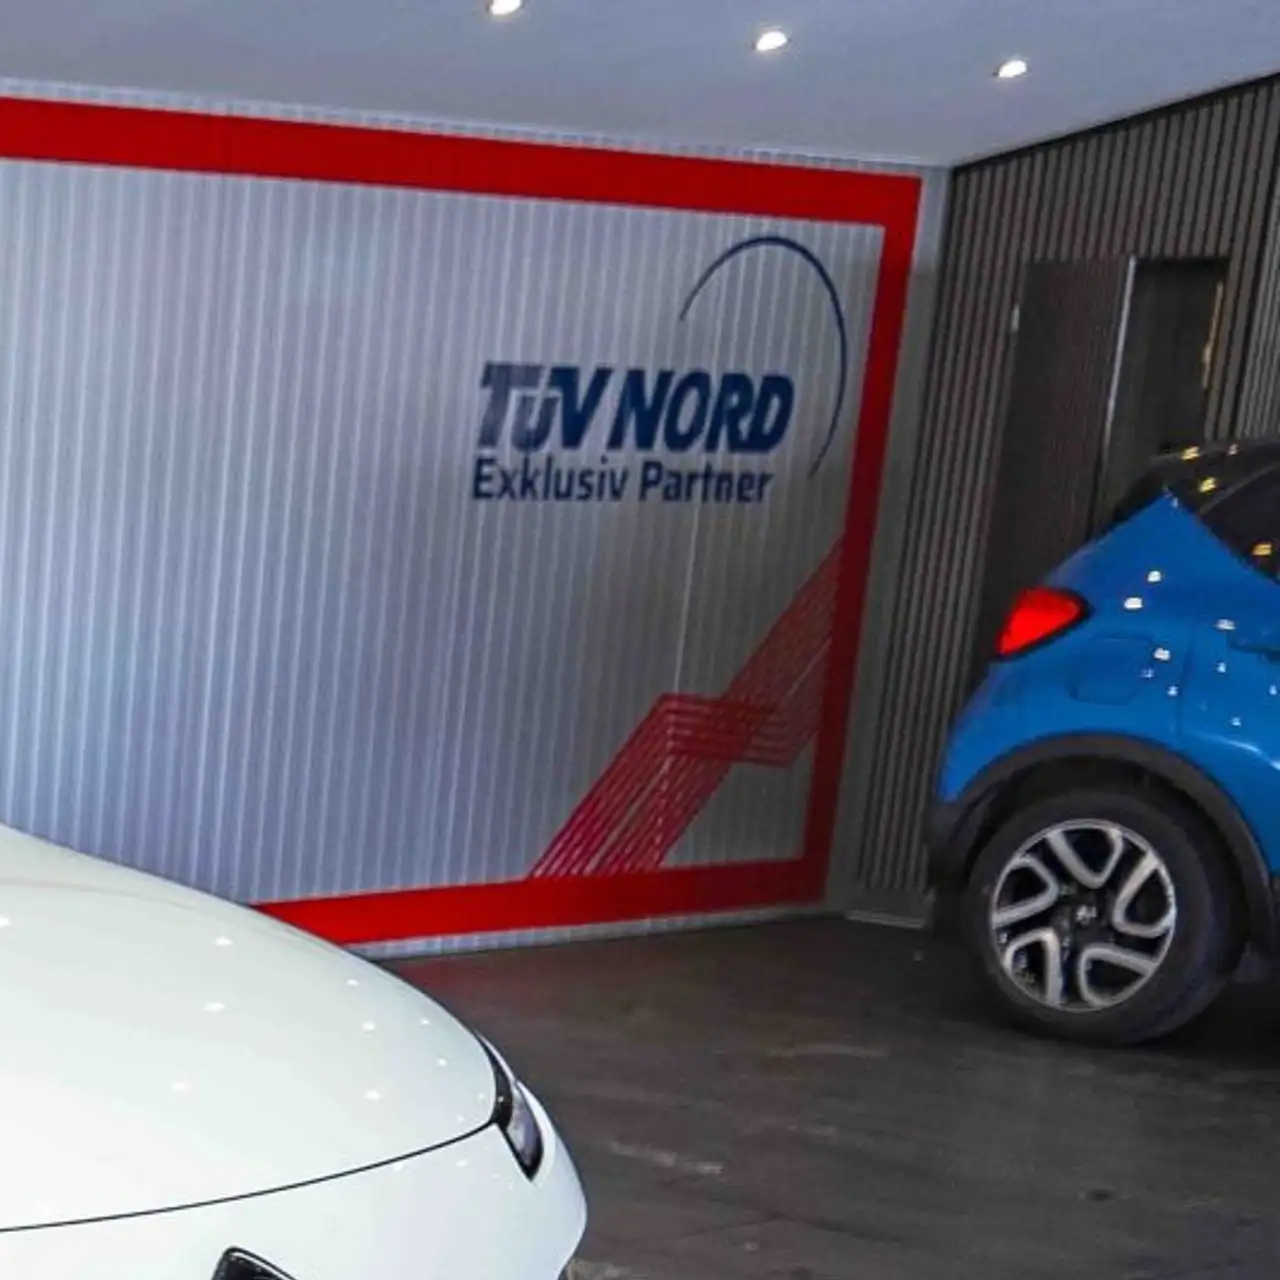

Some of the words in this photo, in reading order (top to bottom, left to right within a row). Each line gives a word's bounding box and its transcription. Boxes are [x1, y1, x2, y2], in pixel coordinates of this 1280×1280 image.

[607, 369, 794, 453] NORD
[473, 456, 628, 501] Exklusiv
[640, 461, 772, 503] Partner
